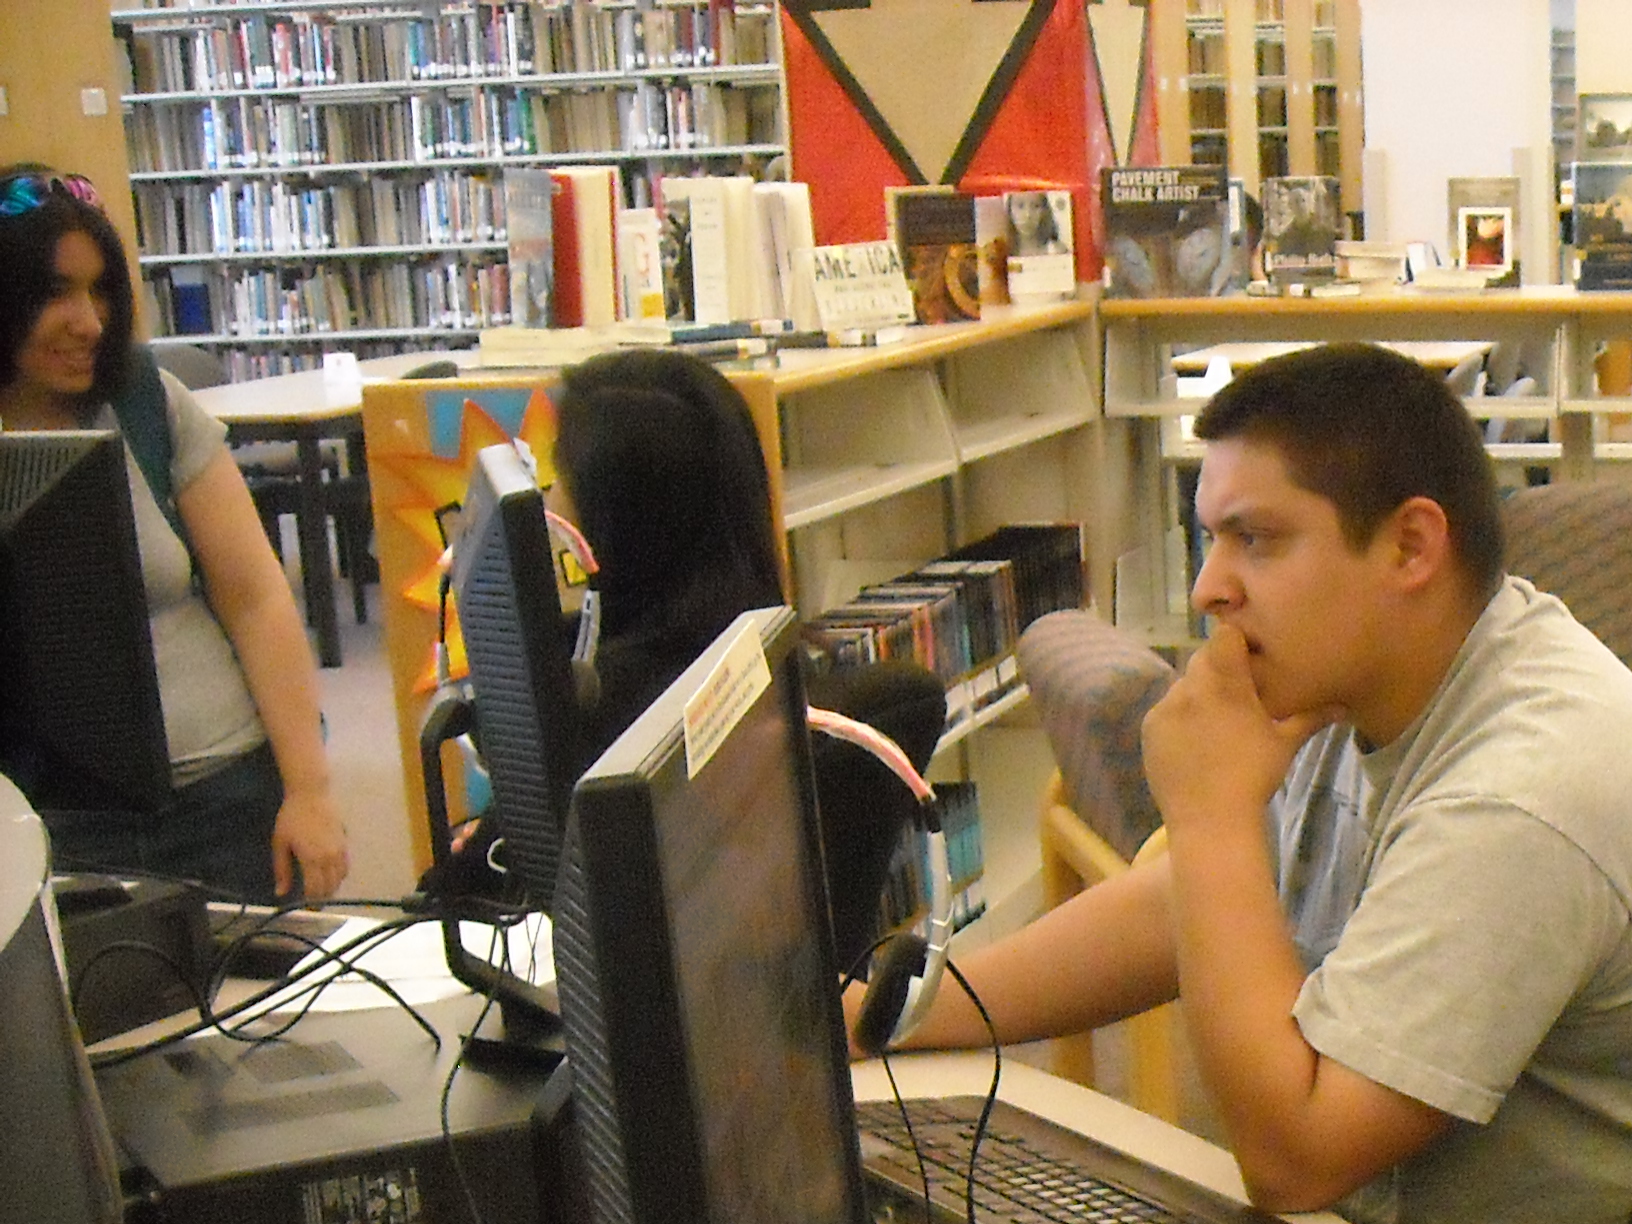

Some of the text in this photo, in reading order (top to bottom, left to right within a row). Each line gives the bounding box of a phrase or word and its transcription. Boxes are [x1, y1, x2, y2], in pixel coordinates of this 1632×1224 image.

[1111, 170, 1180, 186] PAVEMENT
[1112, 185, 1200, 203] CHALK ARTIST
